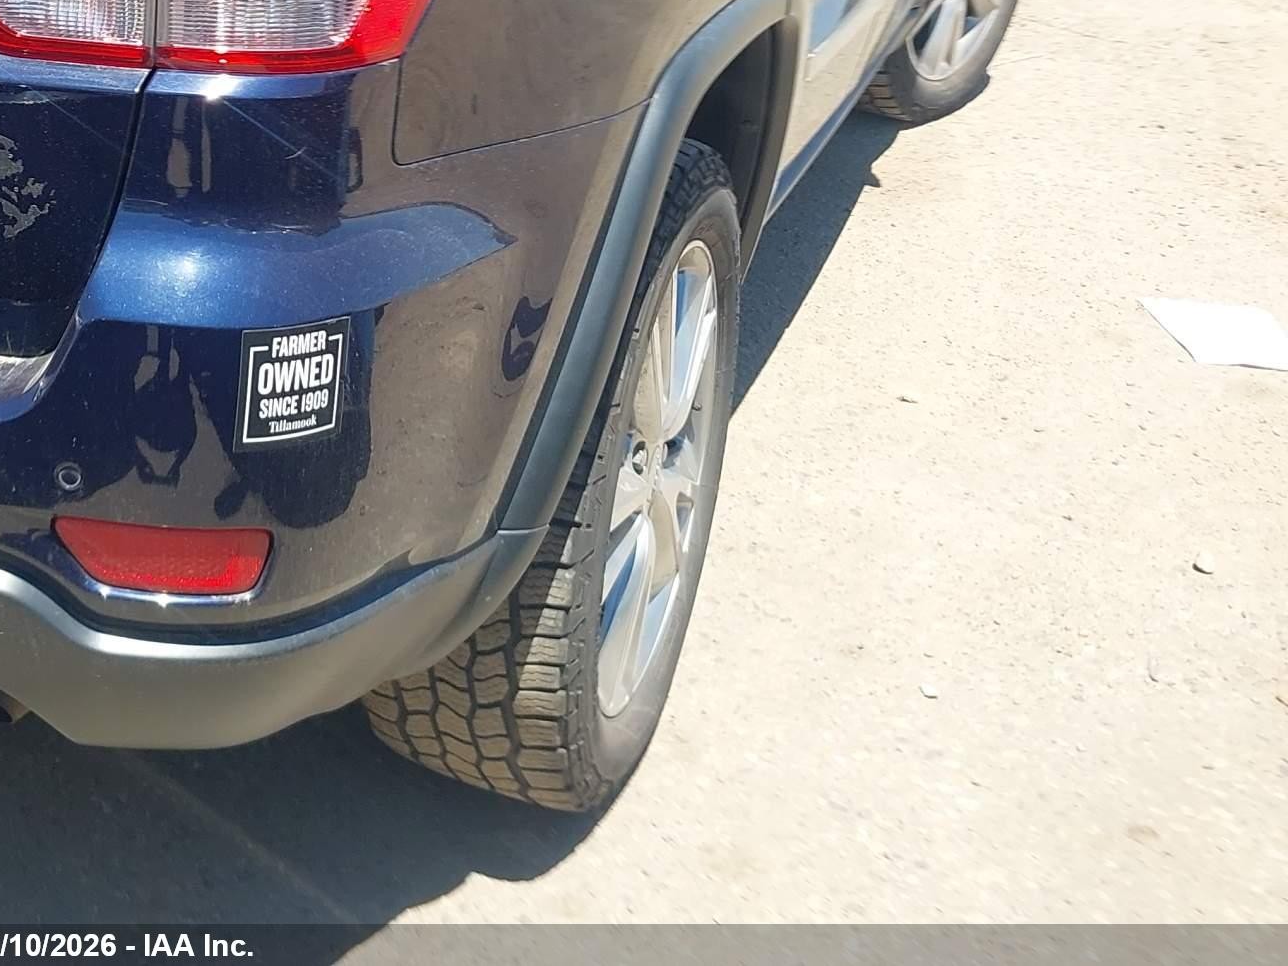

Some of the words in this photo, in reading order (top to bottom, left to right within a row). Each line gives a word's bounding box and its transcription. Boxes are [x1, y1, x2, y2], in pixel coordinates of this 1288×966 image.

[271, 330, 327, 359] FARMER
[257, 353, 335, 396] OWNED
[258, 394, 300, 419] SINCE
[300, 388, 330, 413] 1909
[268, 413, 318, 434] Tillamook
